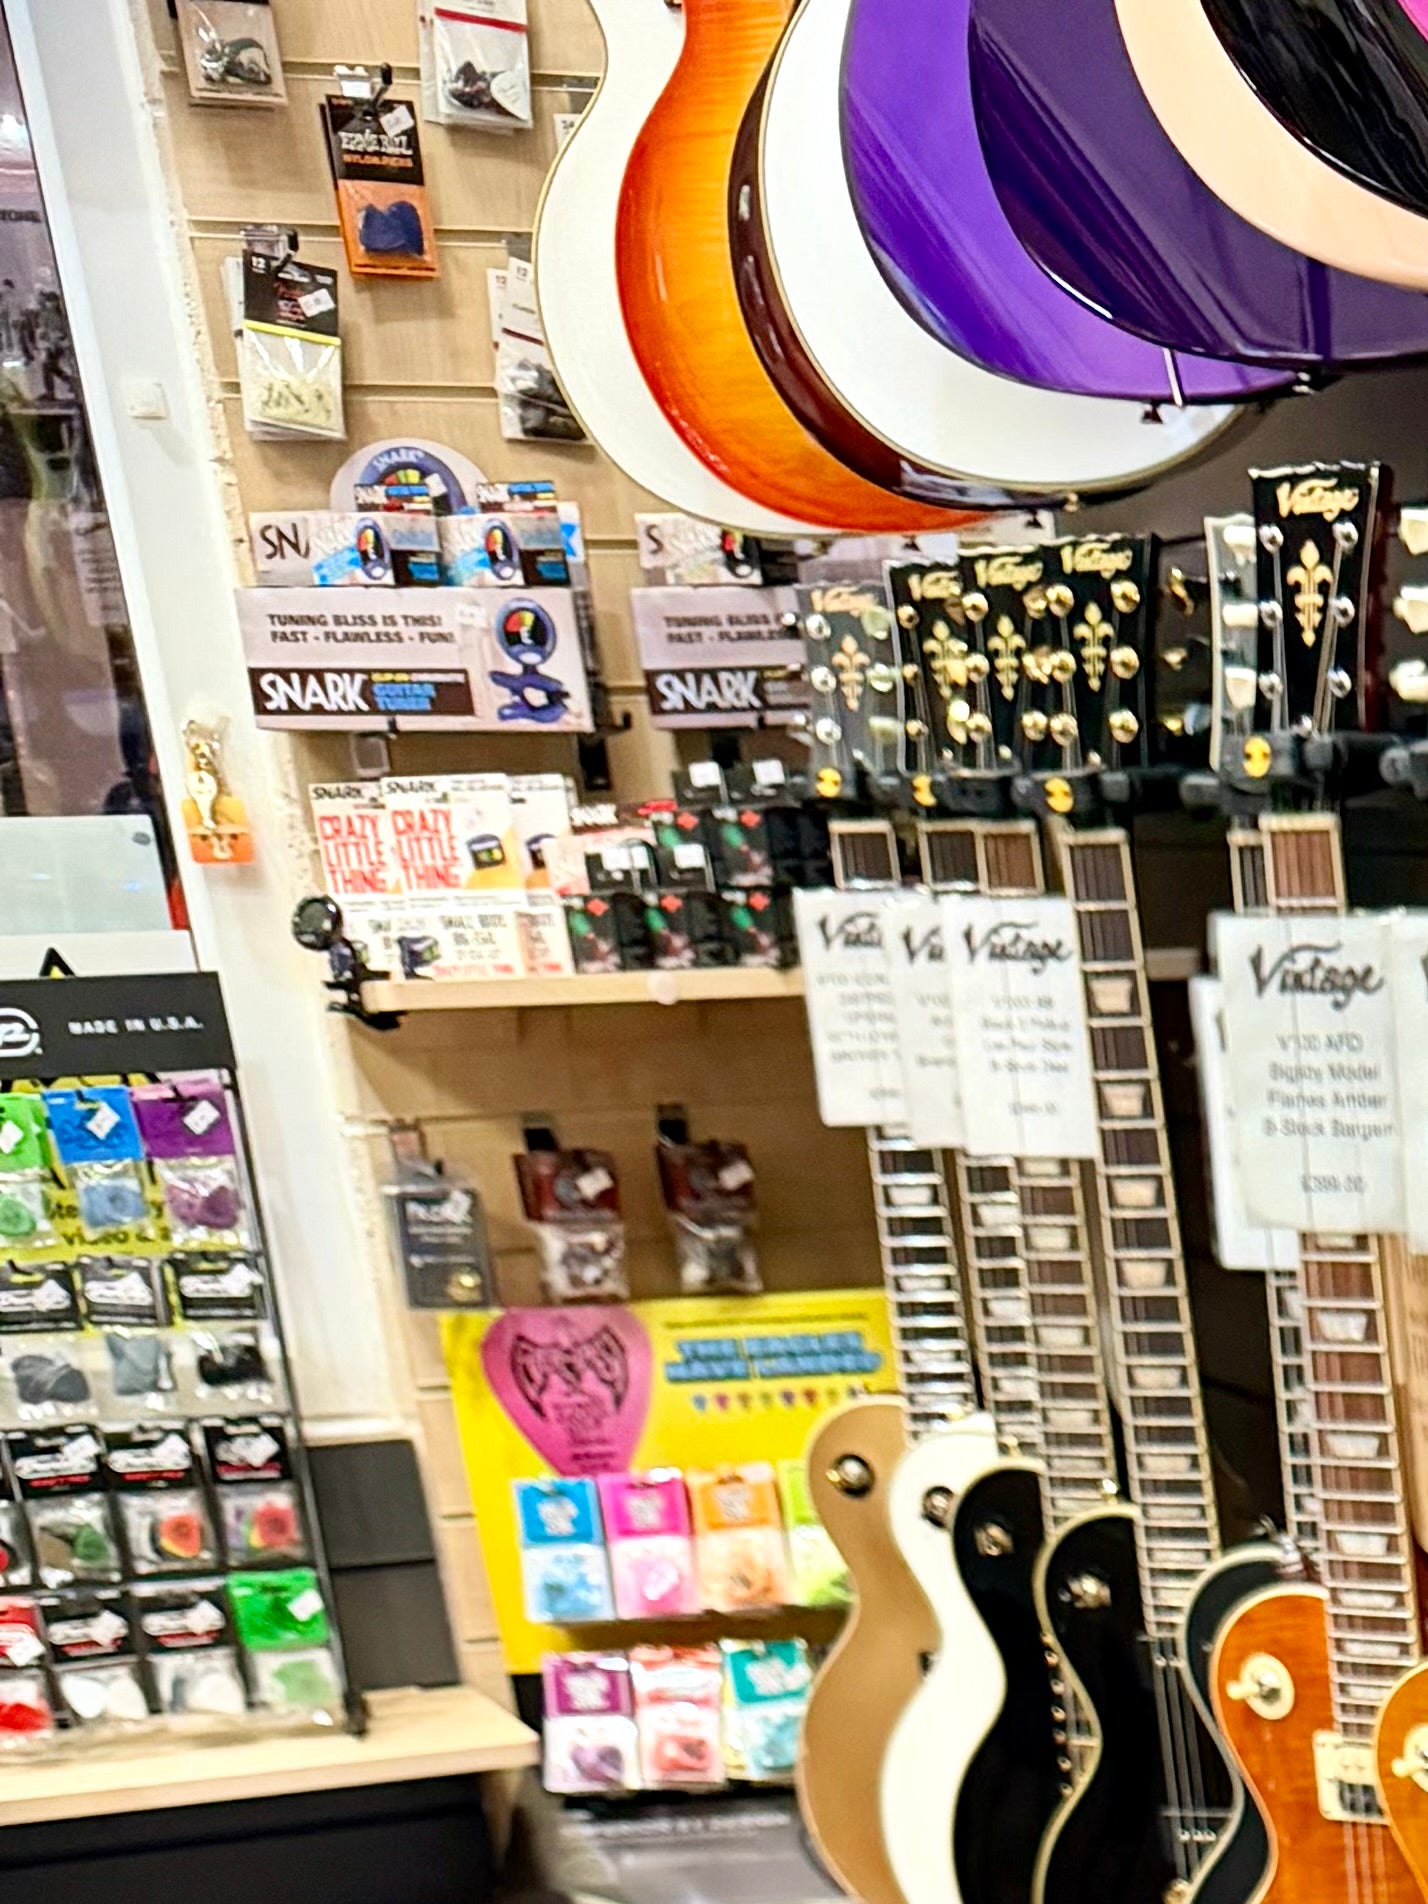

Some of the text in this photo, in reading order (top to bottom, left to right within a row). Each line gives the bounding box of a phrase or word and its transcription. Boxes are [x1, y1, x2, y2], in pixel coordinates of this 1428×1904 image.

[1276, 478, 1360, 520] Vintage
[260, 673, 369, 711] SNARK
[656, 674, 763, 710] SNARK
[319, 815, 380, 841] CRAZY
[391, 809, 452, 837] CRAZY
[322, 840, 386, 868] LITTLE
[395, 836, 459, 866] LITTLE
[328, 866, 387, 895] THING
[401, 863, 462, 892] THING
[1250, 942, 1387, 1011] Vintage
[68, 1020, 118, 1035] MADE
[126, 1018, 146, 1032] IN
